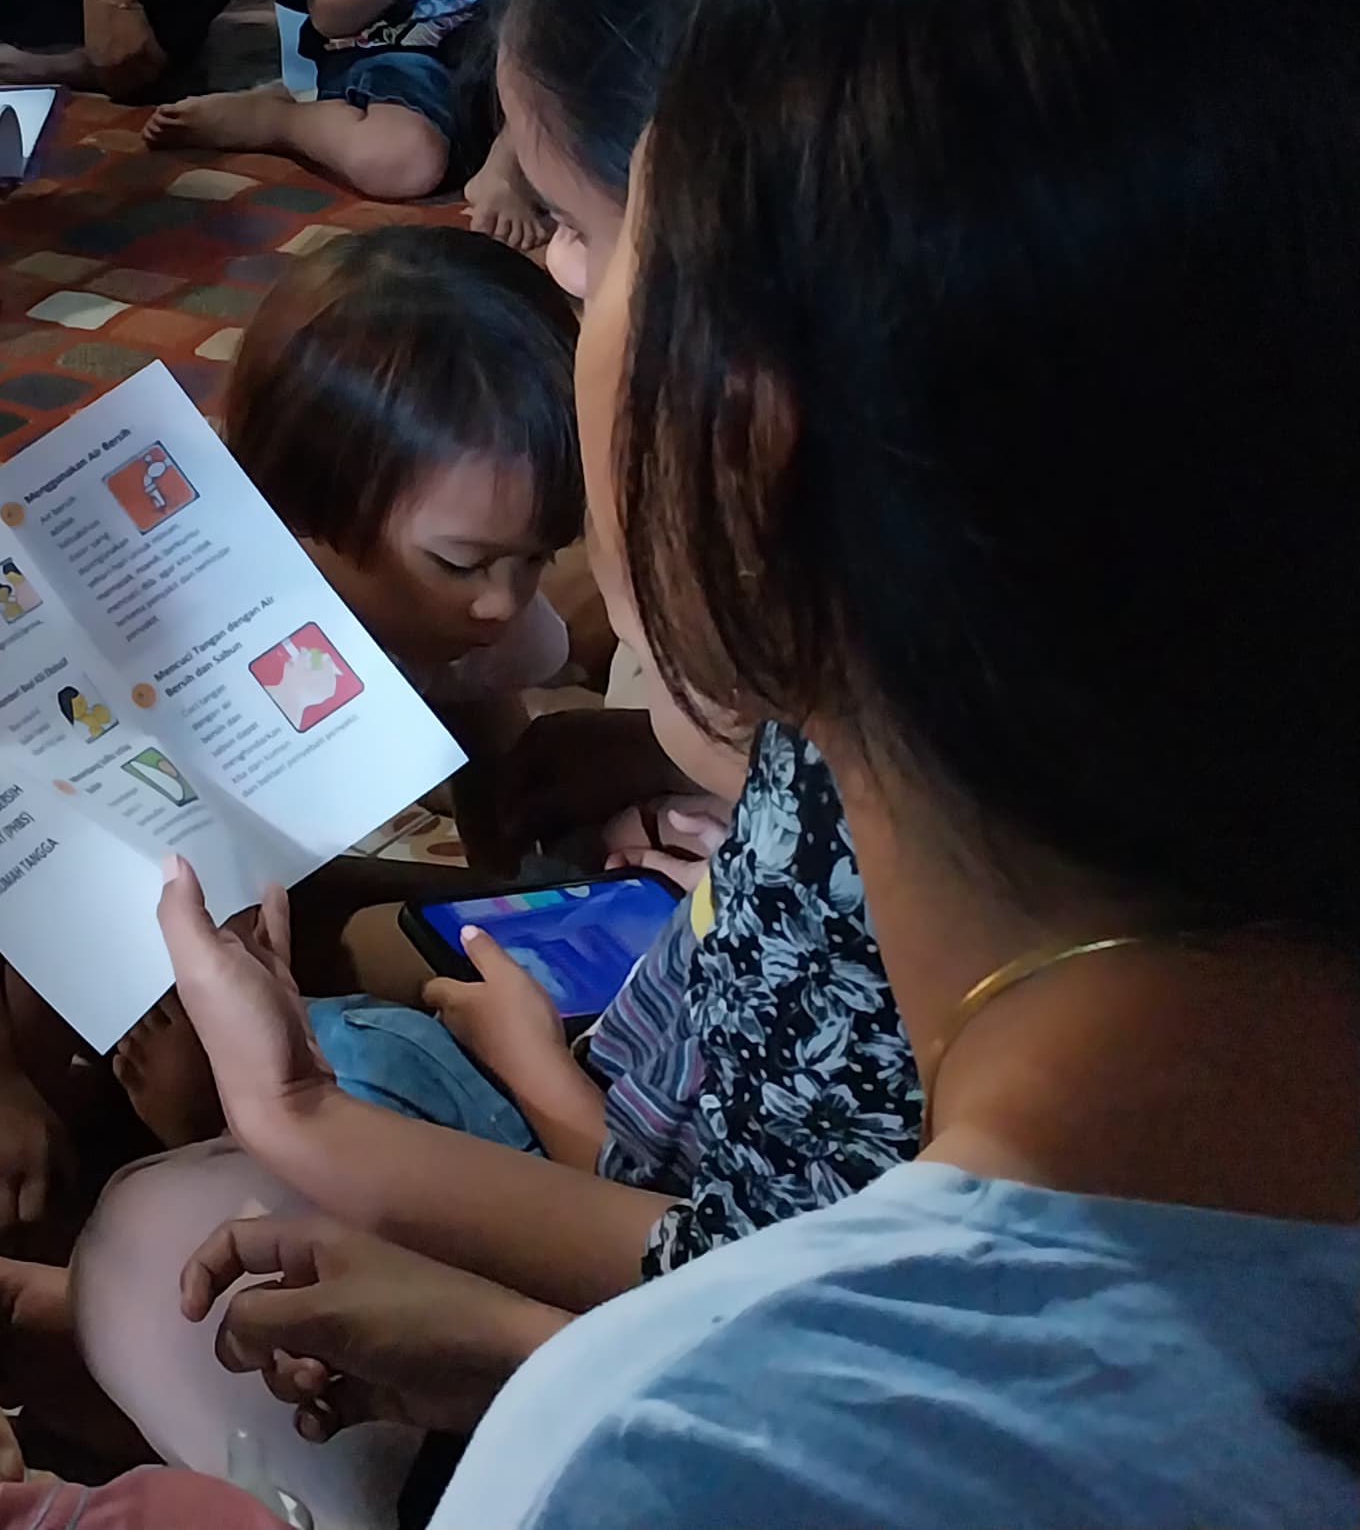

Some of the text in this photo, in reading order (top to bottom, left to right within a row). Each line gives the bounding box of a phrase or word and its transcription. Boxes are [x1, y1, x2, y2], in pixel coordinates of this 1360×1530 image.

[191, 630, 226, 655] Tangan
[195, 662, 213, 677] dan
[212, 642, 242, 664] Sabun
[19, 838, 58, 871] TANGGA
